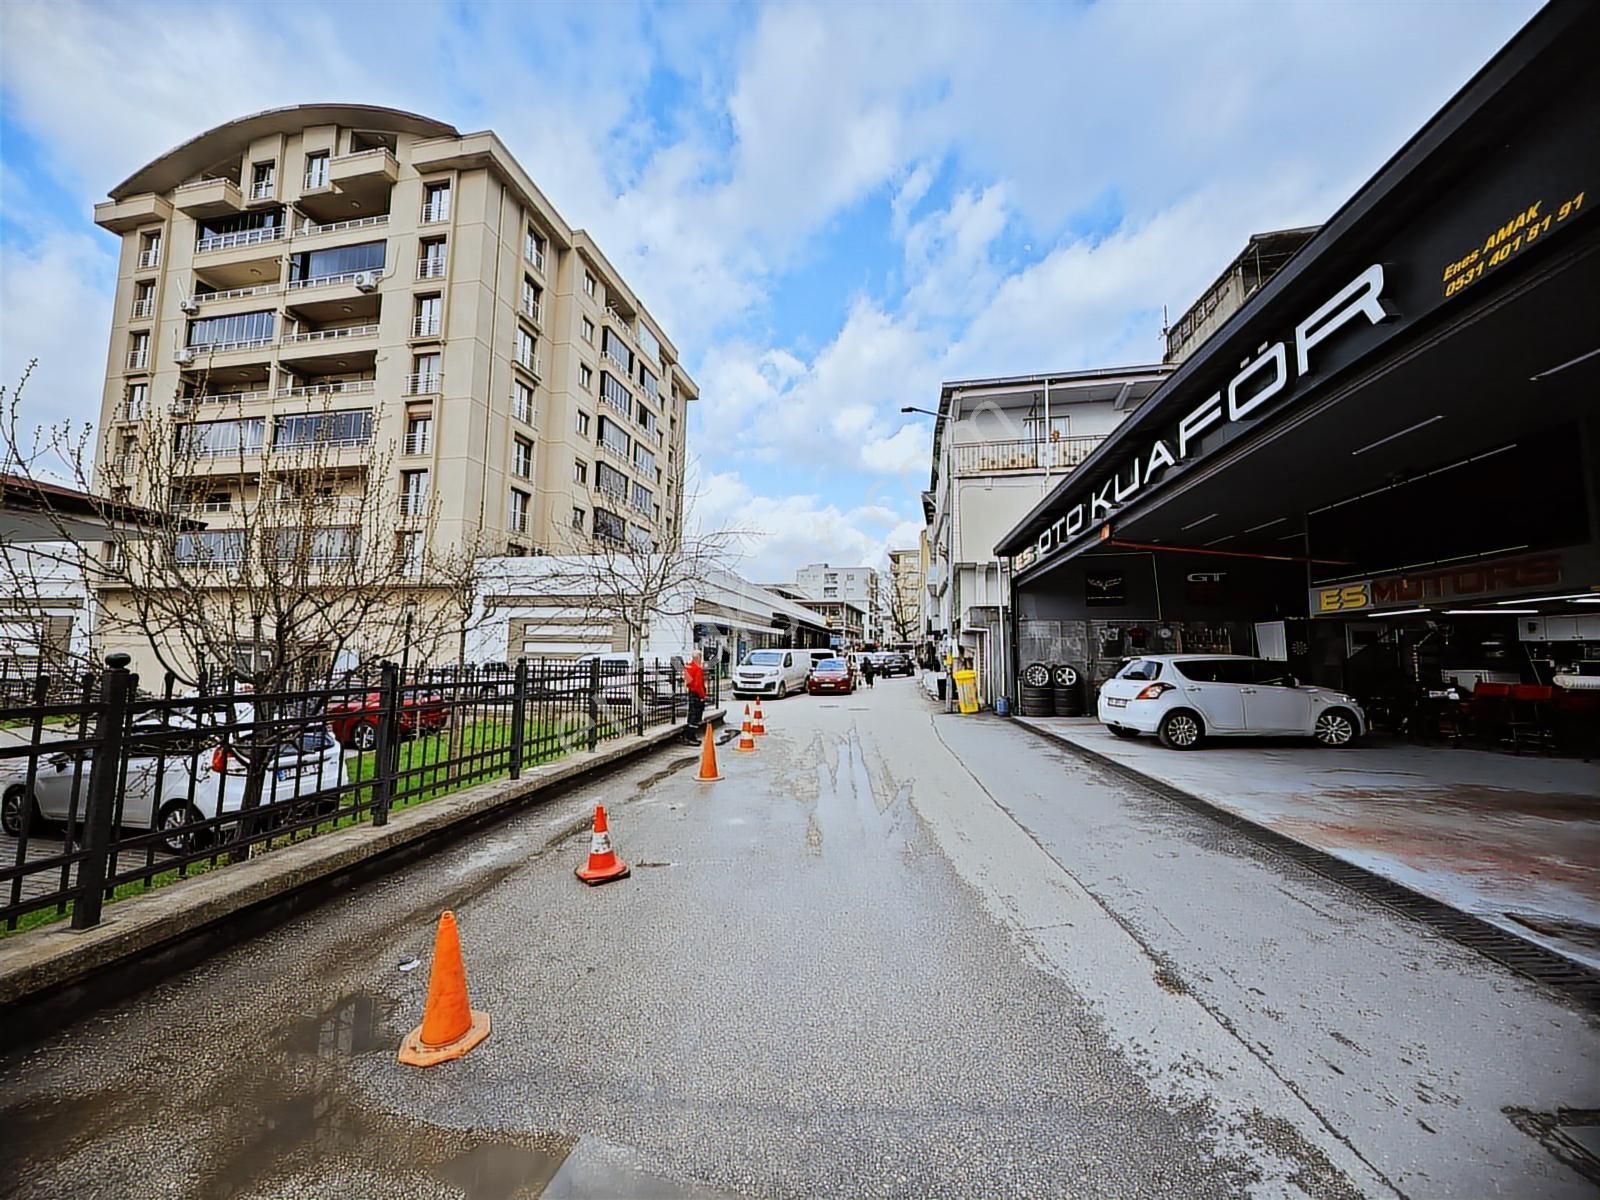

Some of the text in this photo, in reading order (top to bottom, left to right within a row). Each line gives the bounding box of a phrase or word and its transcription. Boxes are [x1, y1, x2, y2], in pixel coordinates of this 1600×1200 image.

[1443, 200, 1542, 281] Enes AMAK
[1488, 235, 1522, 267] 401
[1526, 214, 1552, 242] 81
[1556, 191, 1585, 222] 91
[1039, 503, 1083, 554] OTO
[1091, 263, 1387, 519] KUAFÖR
[1320, 554, 1561, 611] ES MOTORS
